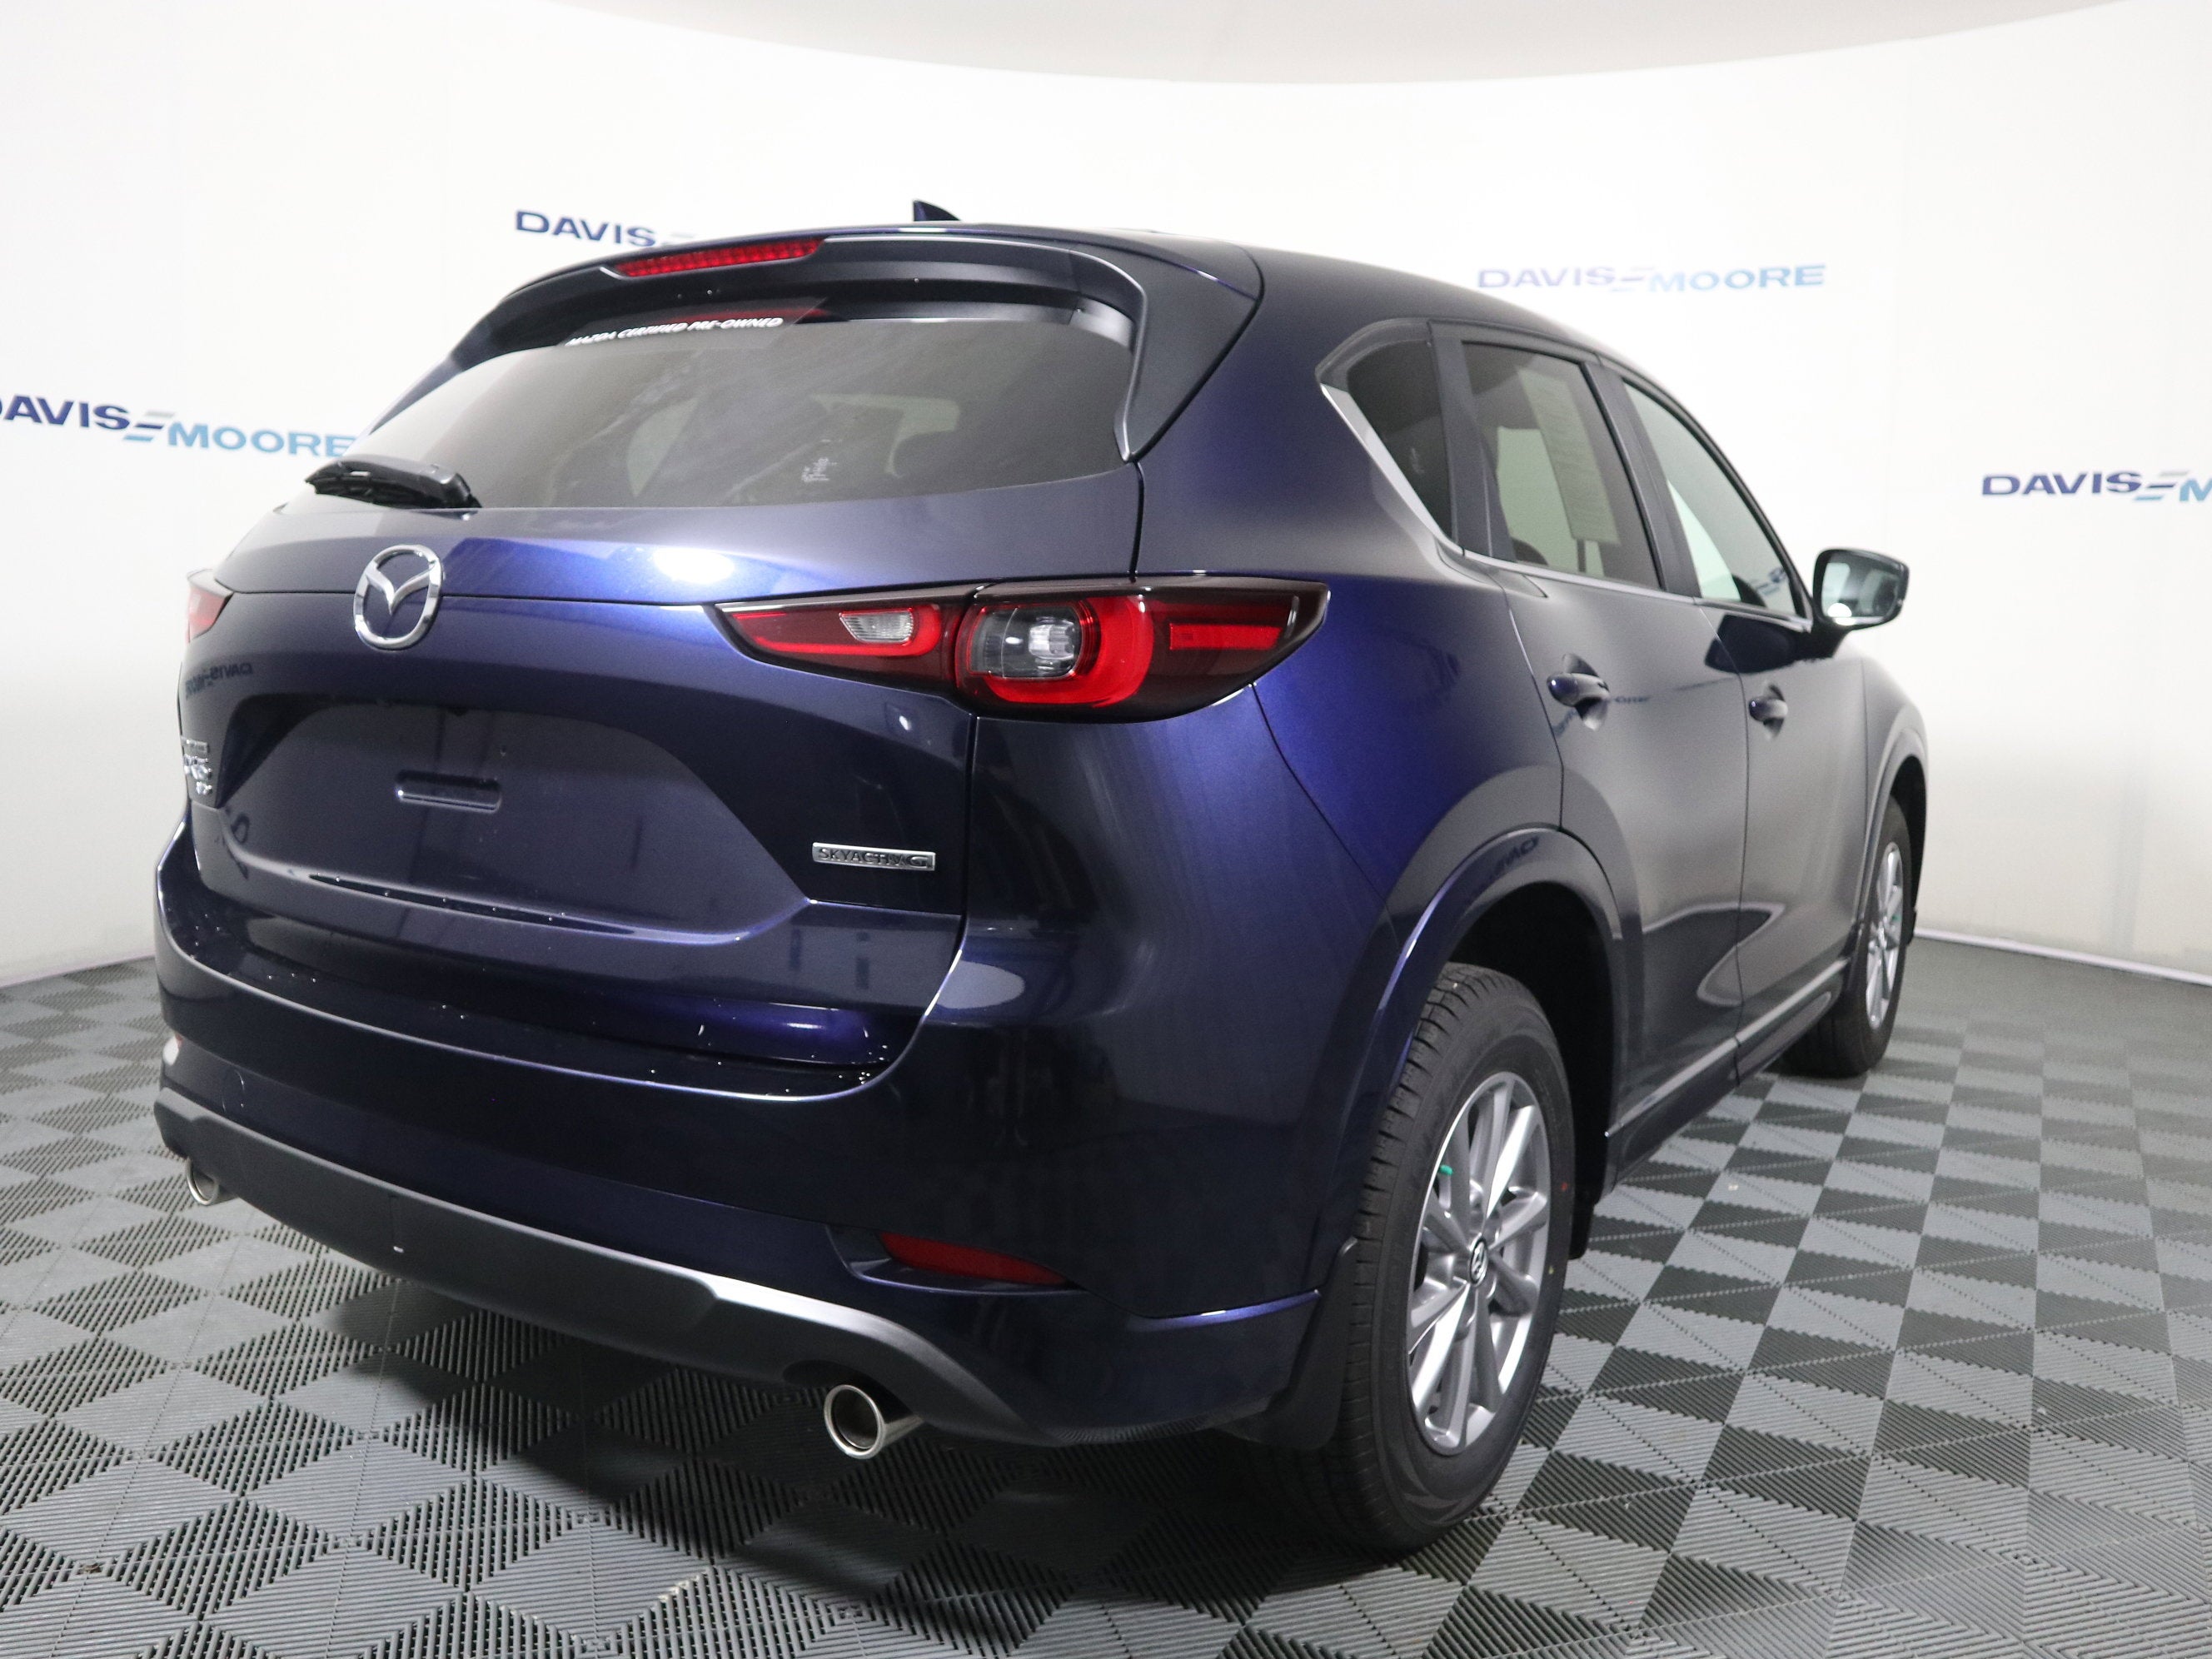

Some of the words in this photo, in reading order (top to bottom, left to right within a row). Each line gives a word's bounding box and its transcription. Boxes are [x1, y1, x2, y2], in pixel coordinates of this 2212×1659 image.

[516, 210, 656, 247] DAVIS
[1477, 266, 1615, 288] DAVIS
[1648, 264, 1826, 291] MOORE
[617, 322, 688, 338] CERTIFIED
[687, 317, 783, 331] PRE-OWNED
[0, 395, 130, 431] AVIS
[167, 421, 356, 458] MOORE
[1982, 471, 2142, 496] DAVIS
